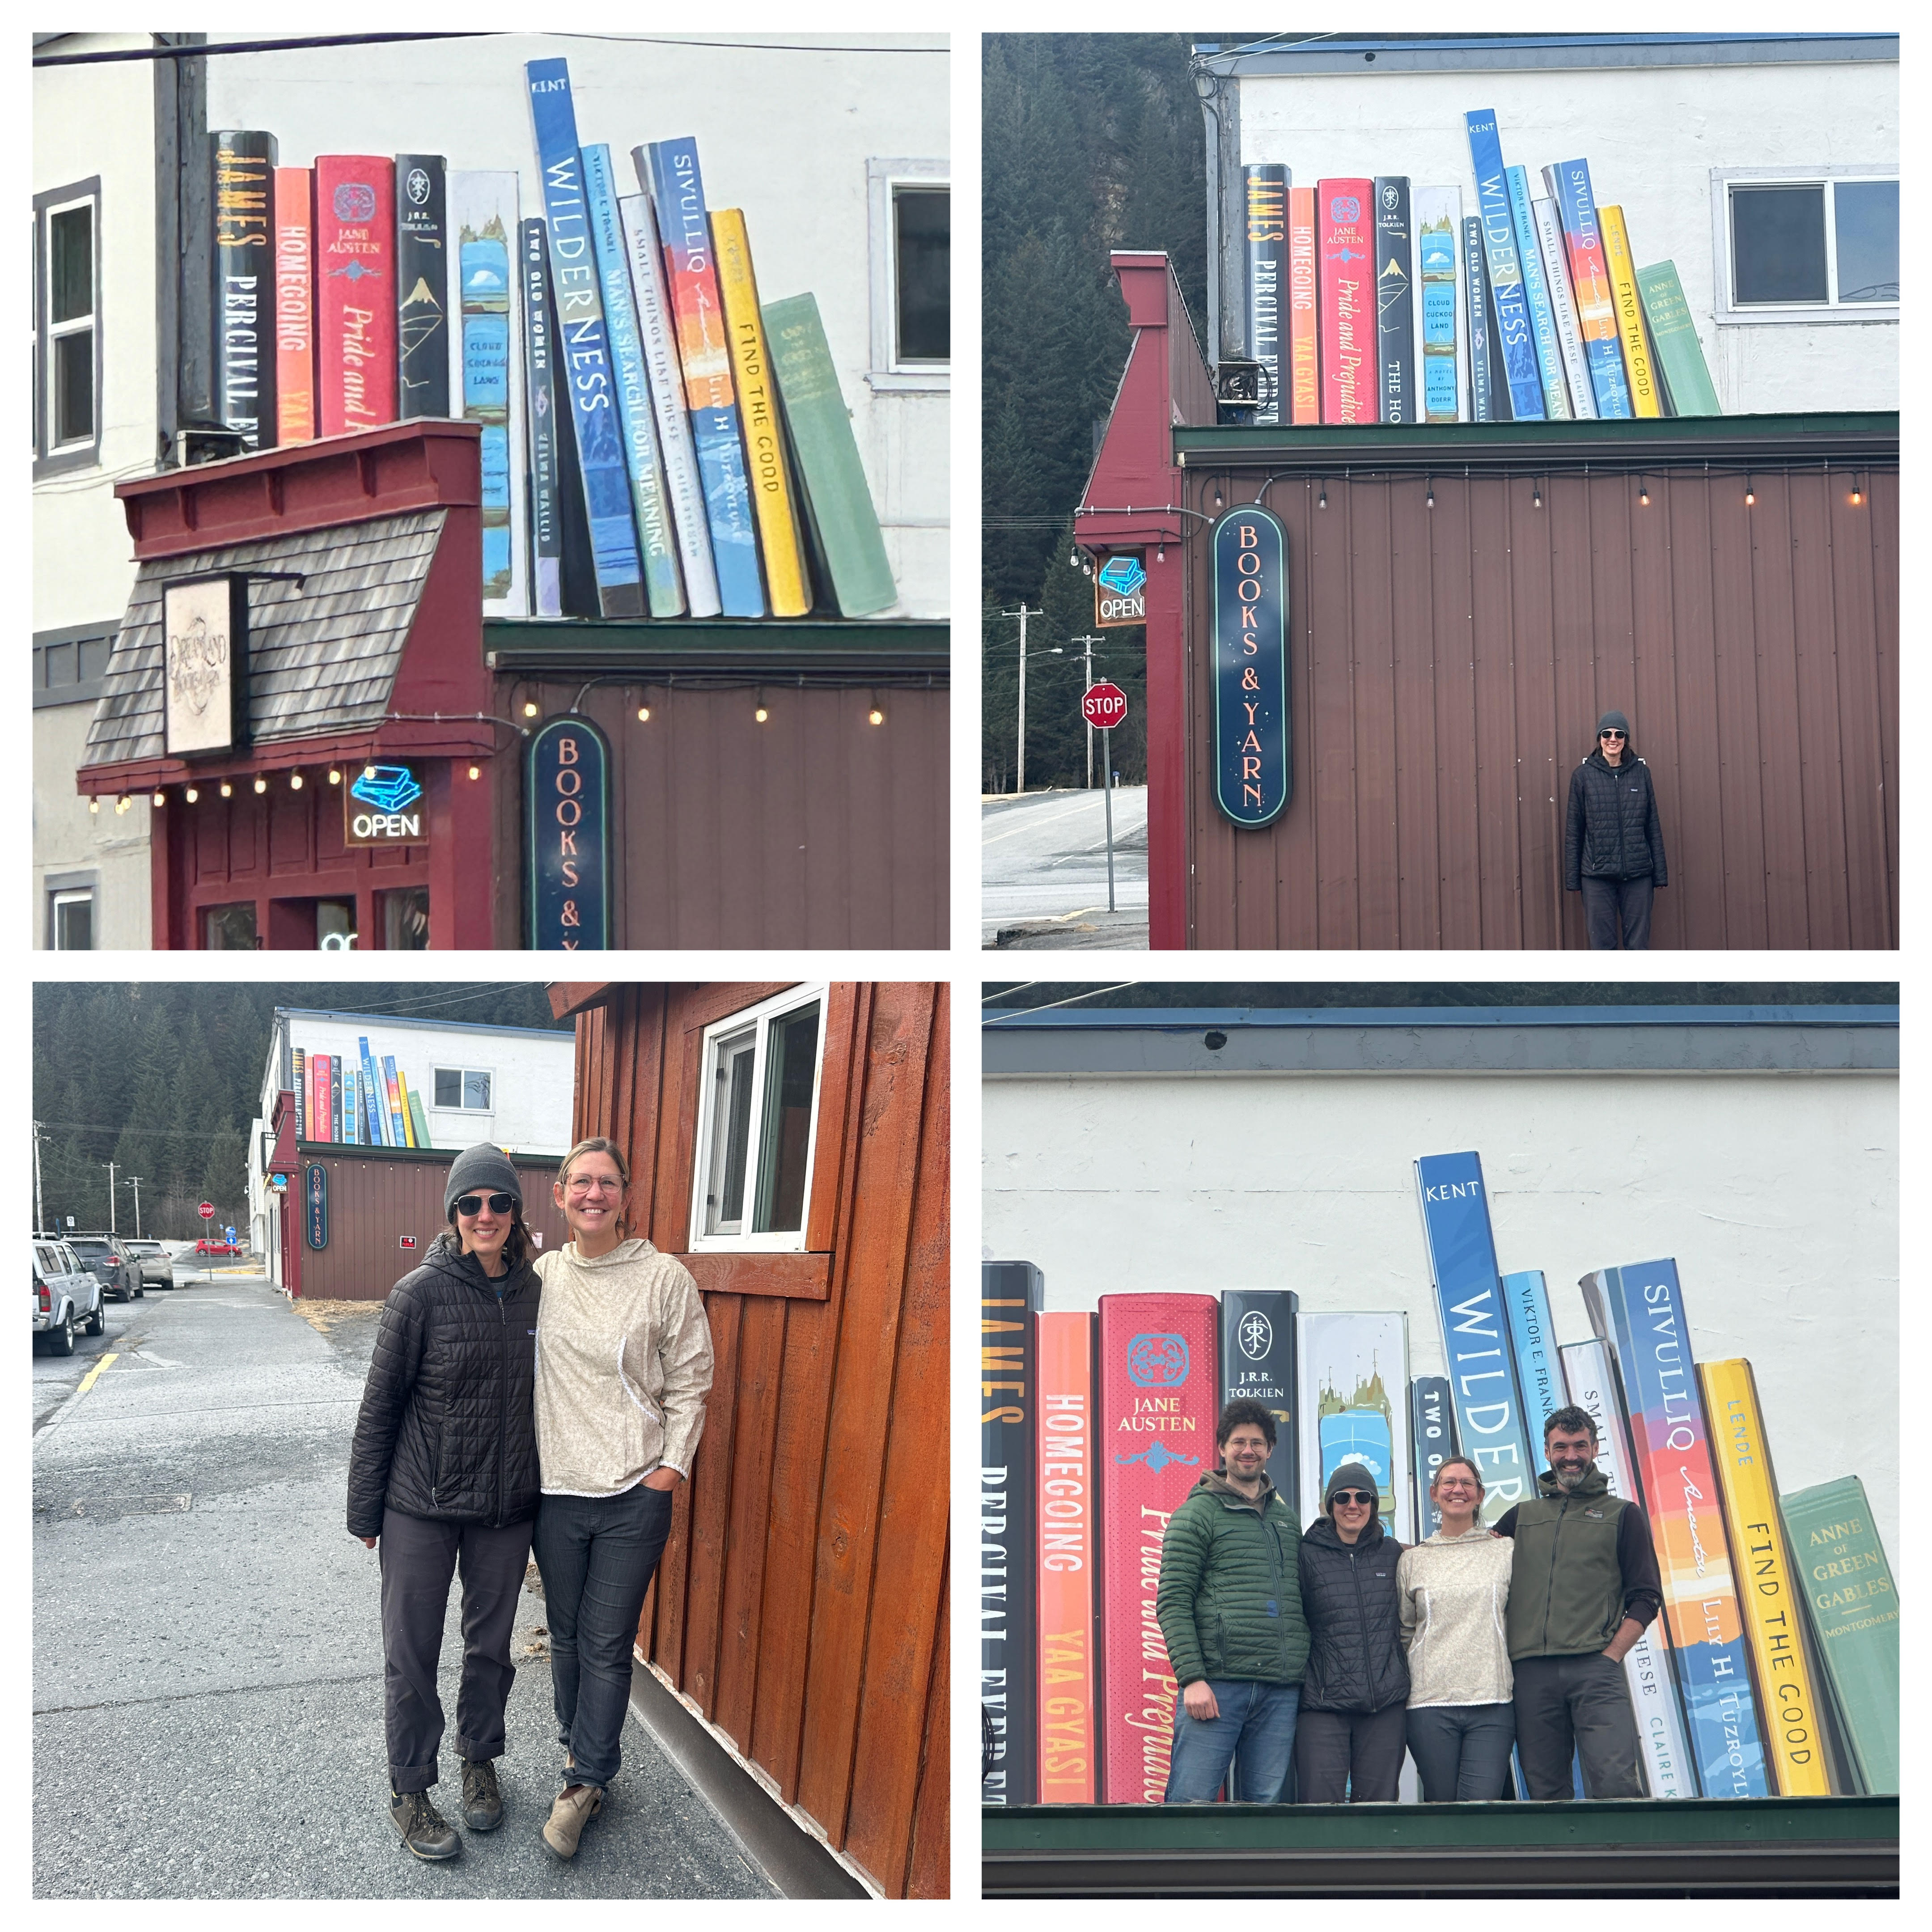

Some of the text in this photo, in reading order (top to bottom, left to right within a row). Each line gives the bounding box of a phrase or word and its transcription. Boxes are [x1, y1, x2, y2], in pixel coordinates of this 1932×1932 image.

[1469, 123, 1495, 134] KENT
[216, 150, 267, 247] JAMES
[674, 155, 706, 274] SIVULLIQ
[1248, 177, 1284, 242] JAMES
[1514, 174, 1530, 240] VIKTOR FRANKL
[1572, 170, 1596, 250] SIVULLIQ
[529, 228, 540, 261] TWO
[1469, 223, 1478, 246] TWO
[1610, 224, 1623, 257] LENDE
[1480, 174, 1527, 346] WILDERNESS
[277, 226, 309, 352] HOMEGOING
[547, 156, 609, 412] WILDERNESS
[1254, 259, 1278, 346] PERCIVAL
[1472, 277, 1482, 318] WOMEN
[1543, 221, 1578, 365] SMALL THINGS LIKE THESE
[1648, 280, 1675, 295] ANNE
[1651, 295, 1682, 311] GREEN
[1293, 226, 1315, 408] HOMEGOING YAA GYASI
[1525, 249, 1541, 290] MAN'S
[1533, 292, 1552, 346] SEARCH
[1543, 348, 1557, 376] FOR
[1598, 318, 1609, 341] LILY
[1652, 306, 1687, 324] GABLES
[1656, 322, 1691, 338] MONTGOMERY
[225, 275, 258, 403] PERCIVAL
[340, 305, 375, 368] Pride
[1332, 277, 1364, 424] Pride and Prejudice
[1619, 282, 1649, 397] FIND THE GOOD
[343, 370, 376, 416] and
[1388, 361, 1401, 394] THE
[1477, 360, 1486, 394] VELMA
[1574, 373, 1587, 404] CLAIRE
[740, 324, 779, 492] FIND THE GOOD
[1100, 597, 1144, 618] OPEN
[1237, 526, 1263, 807] BOOKS & YARN
[1085, 696, 1123, 715] STOP
[353, 814, 419, 838] OPEN
[555, 738, 582, 887] BOOKS
[560, 901, 580, 927] &
[292, 1051, 304, 1073] JAMES
[363, 1058, 376, 1113] WILDERNESS
[318, 1110, 327, 1133] Prejudice
[1426, 1181, 1479, 1202] KENT
[1521, 1288, 1554, 1417] VIKTOR E. FRANK
[1644, 1284, 1695, 1451] SIVULLIQ
[1229, 1388, 1284, 1398] TOLKIEN
[1239, 1372, 1273, 1385] J.R.R.
[1118, 1416, 1196, 1432] AUSTEN
[1133, 1398, 1180, 1415] JANE
[1424, 1391, 1441, 1439] TWO
[1727, 1399, 1754, 1467] LENDE
[1809, 1518, 1863, 1547] ANNE
[1812, 1551, 1878, 1581] GREEN
[1044, 1394, 1086, 1784] HOMEGOING YAA GYASI
[1816, 1576, 1891, 1610] GABLES
[1702, 1598, 1723, 1647] LILY
[1747, 1522, 1811, 1765] FIND THE GOOD
[1825, 1610, 1899, 1639] MONTGOMERY
[1711, 1655, 1734, 1684] H.
[1635, 1635, 1674, 1780] HESE CLAIRE
